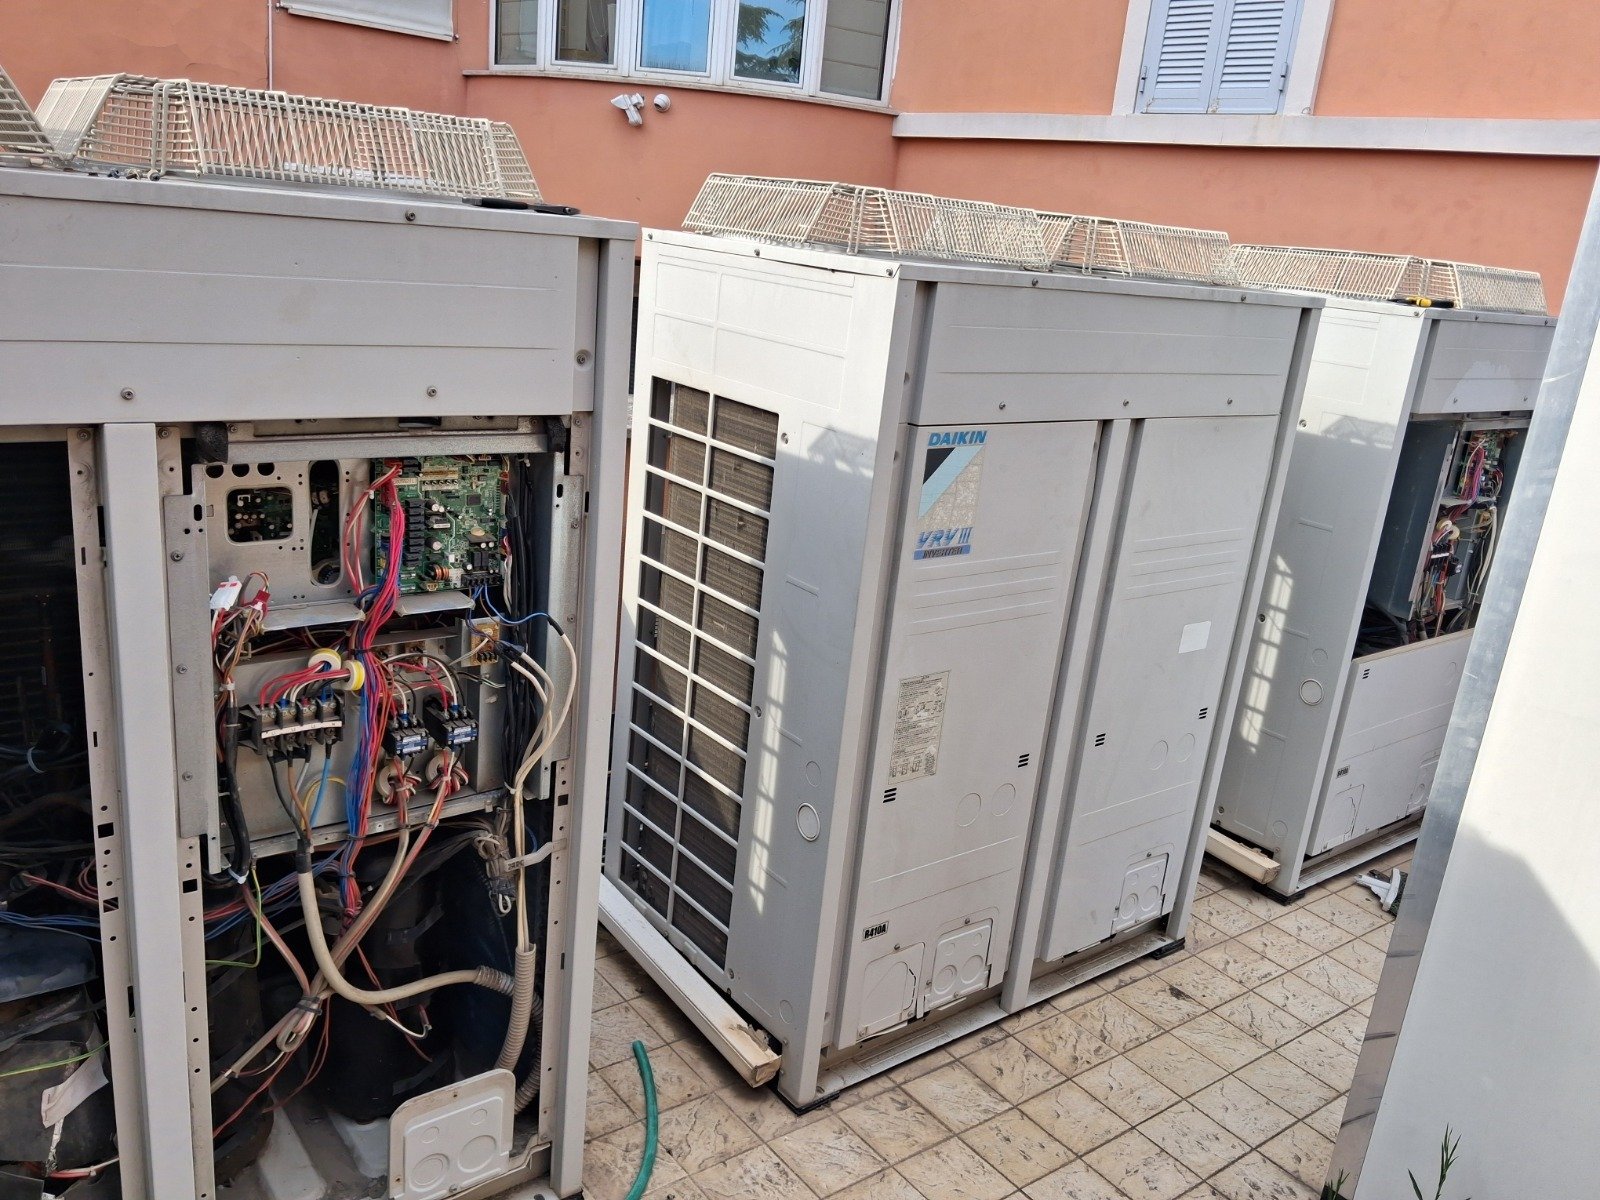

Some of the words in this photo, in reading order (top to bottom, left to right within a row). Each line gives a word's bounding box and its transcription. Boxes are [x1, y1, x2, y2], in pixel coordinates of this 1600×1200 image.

[928, 430, 987, 446] DAIKIN
[915, 527, 959, 548] VRV
[864, 923, 886, 939] R410A
